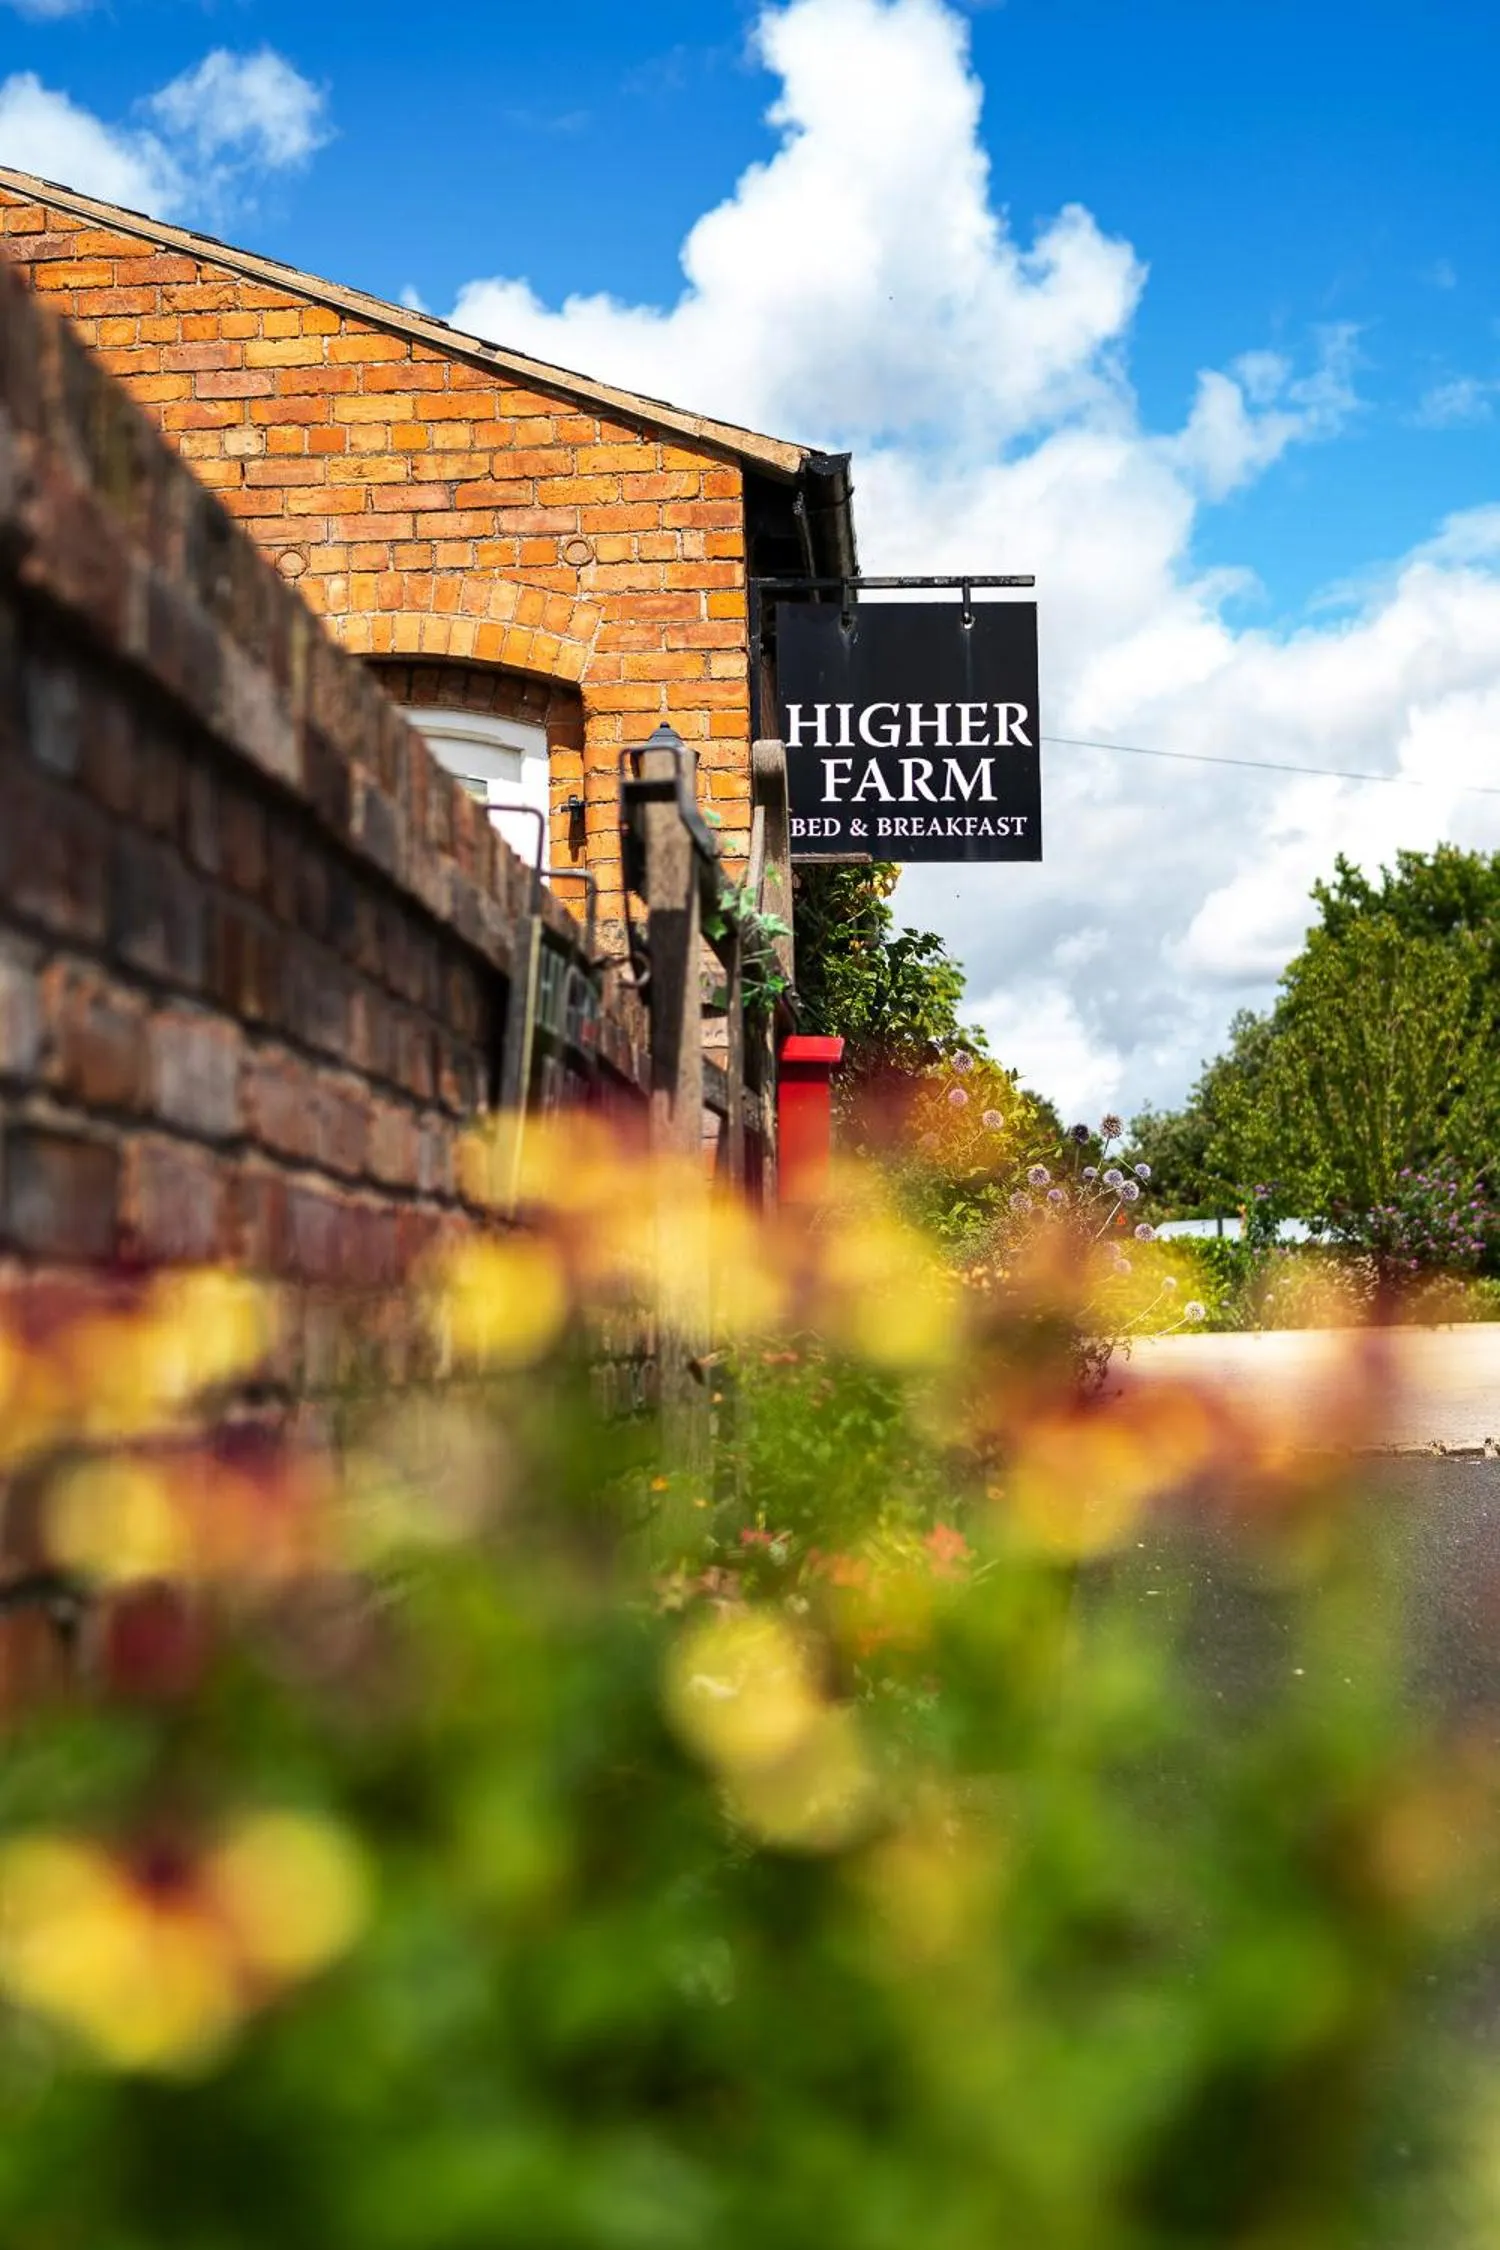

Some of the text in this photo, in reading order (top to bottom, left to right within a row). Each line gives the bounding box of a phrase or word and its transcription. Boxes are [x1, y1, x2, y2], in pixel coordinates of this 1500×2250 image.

[785, 702, 1033, 748] HIGHER
[820, 757, 998, 803] FARM
[790, 816, 1028, 837] BED & BREAKFAST
